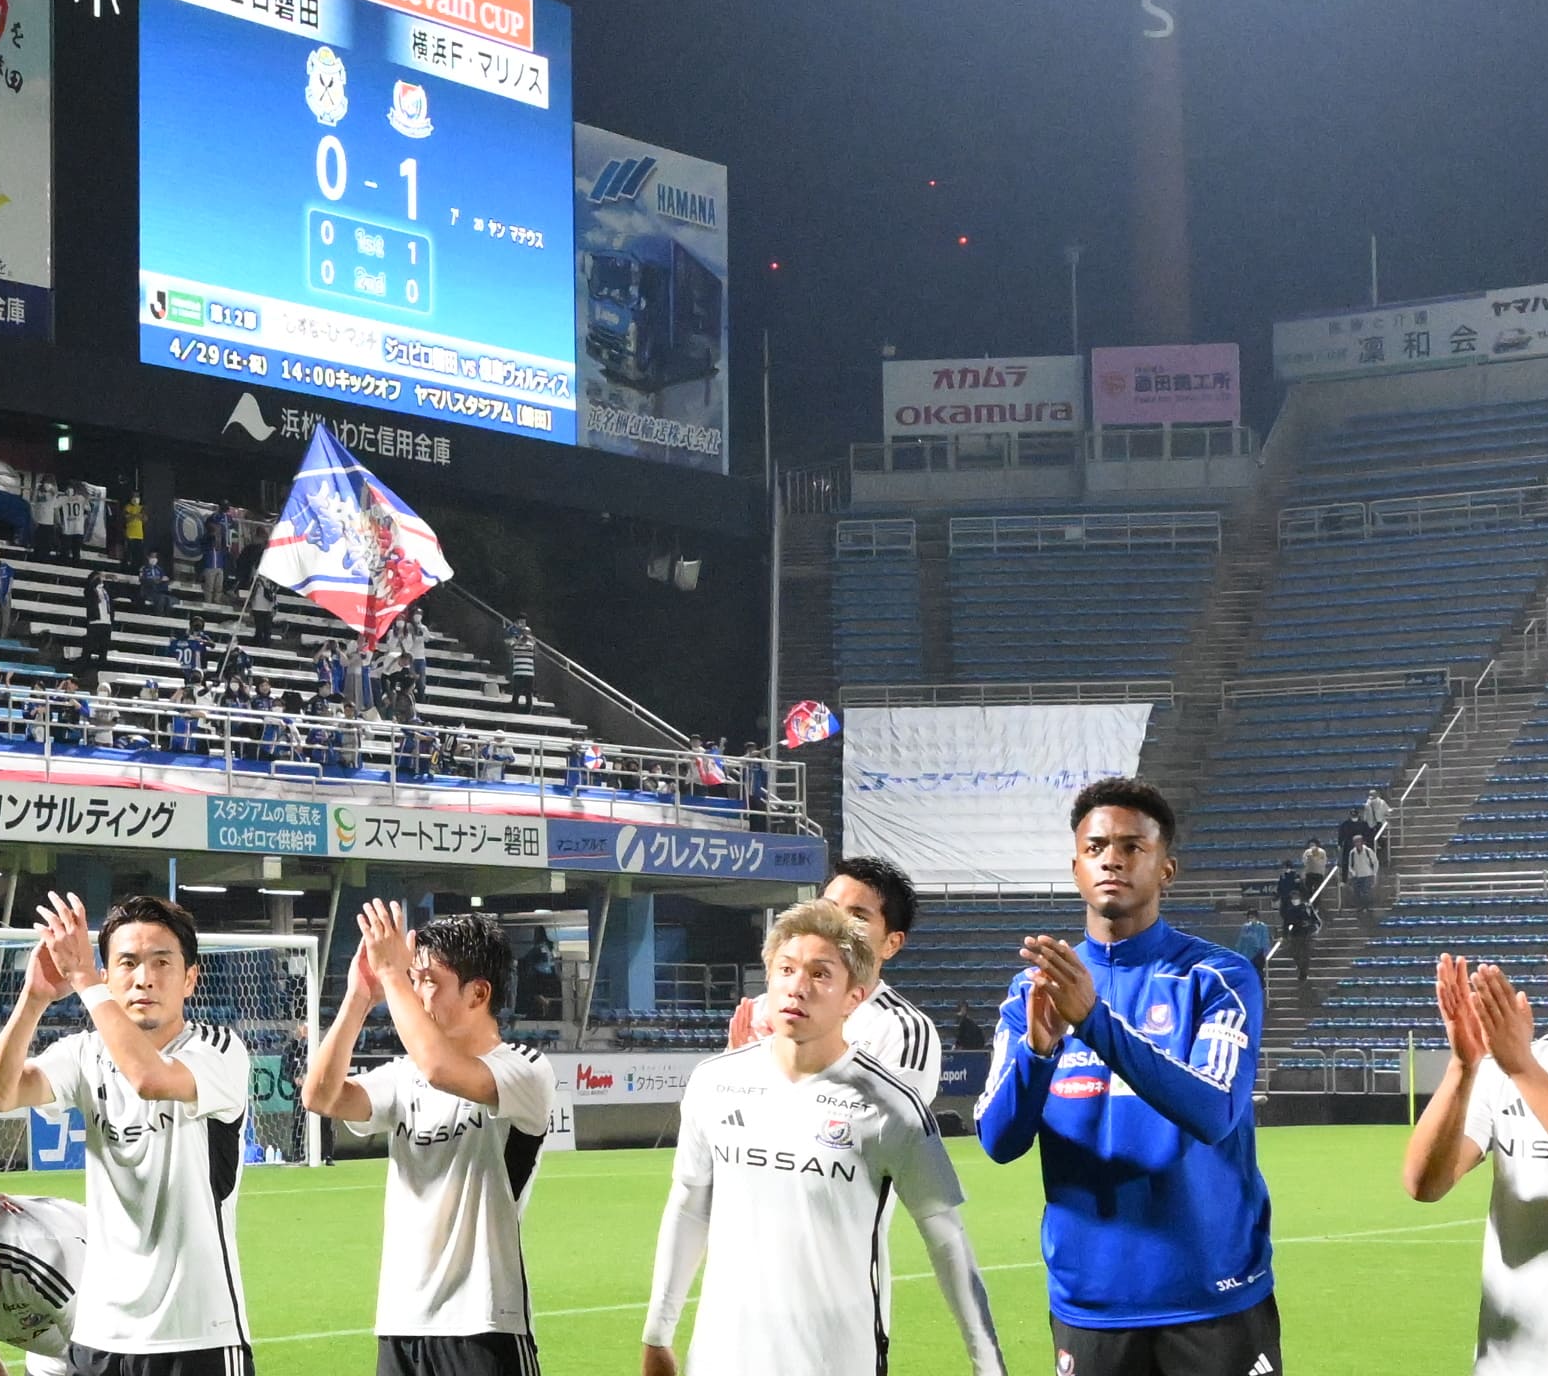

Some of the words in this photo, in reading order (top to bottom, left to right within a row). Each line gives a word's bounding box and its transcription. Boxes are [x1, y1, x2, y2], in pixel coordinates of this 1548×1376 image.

[479, 3, 525, 38] CUP
[412, 27, 544, 96] 横浜F・マリノス
[399, 157, 419, 221] 1
[657, 183, 716, 226] HAMANA
[320, 219, 335, 246] 0
[407, 241, 418, 266] 1
[320, 259, 335, 285] 0
[406, 279, 420, 304] 0
[932, 366, 1027, 390] オカムラ
[212, 797, 322, 827] スタジアムの電気を
[364, 816, 541, 858] スマートエナジー磐田
[649, 833, 764, 872] クレステック
[815, 1093, 873, 1114] DRAFT
[714, 1143, 857, 1183] NISSAN
[1216, 1276, 1243, 1293] 3XL
